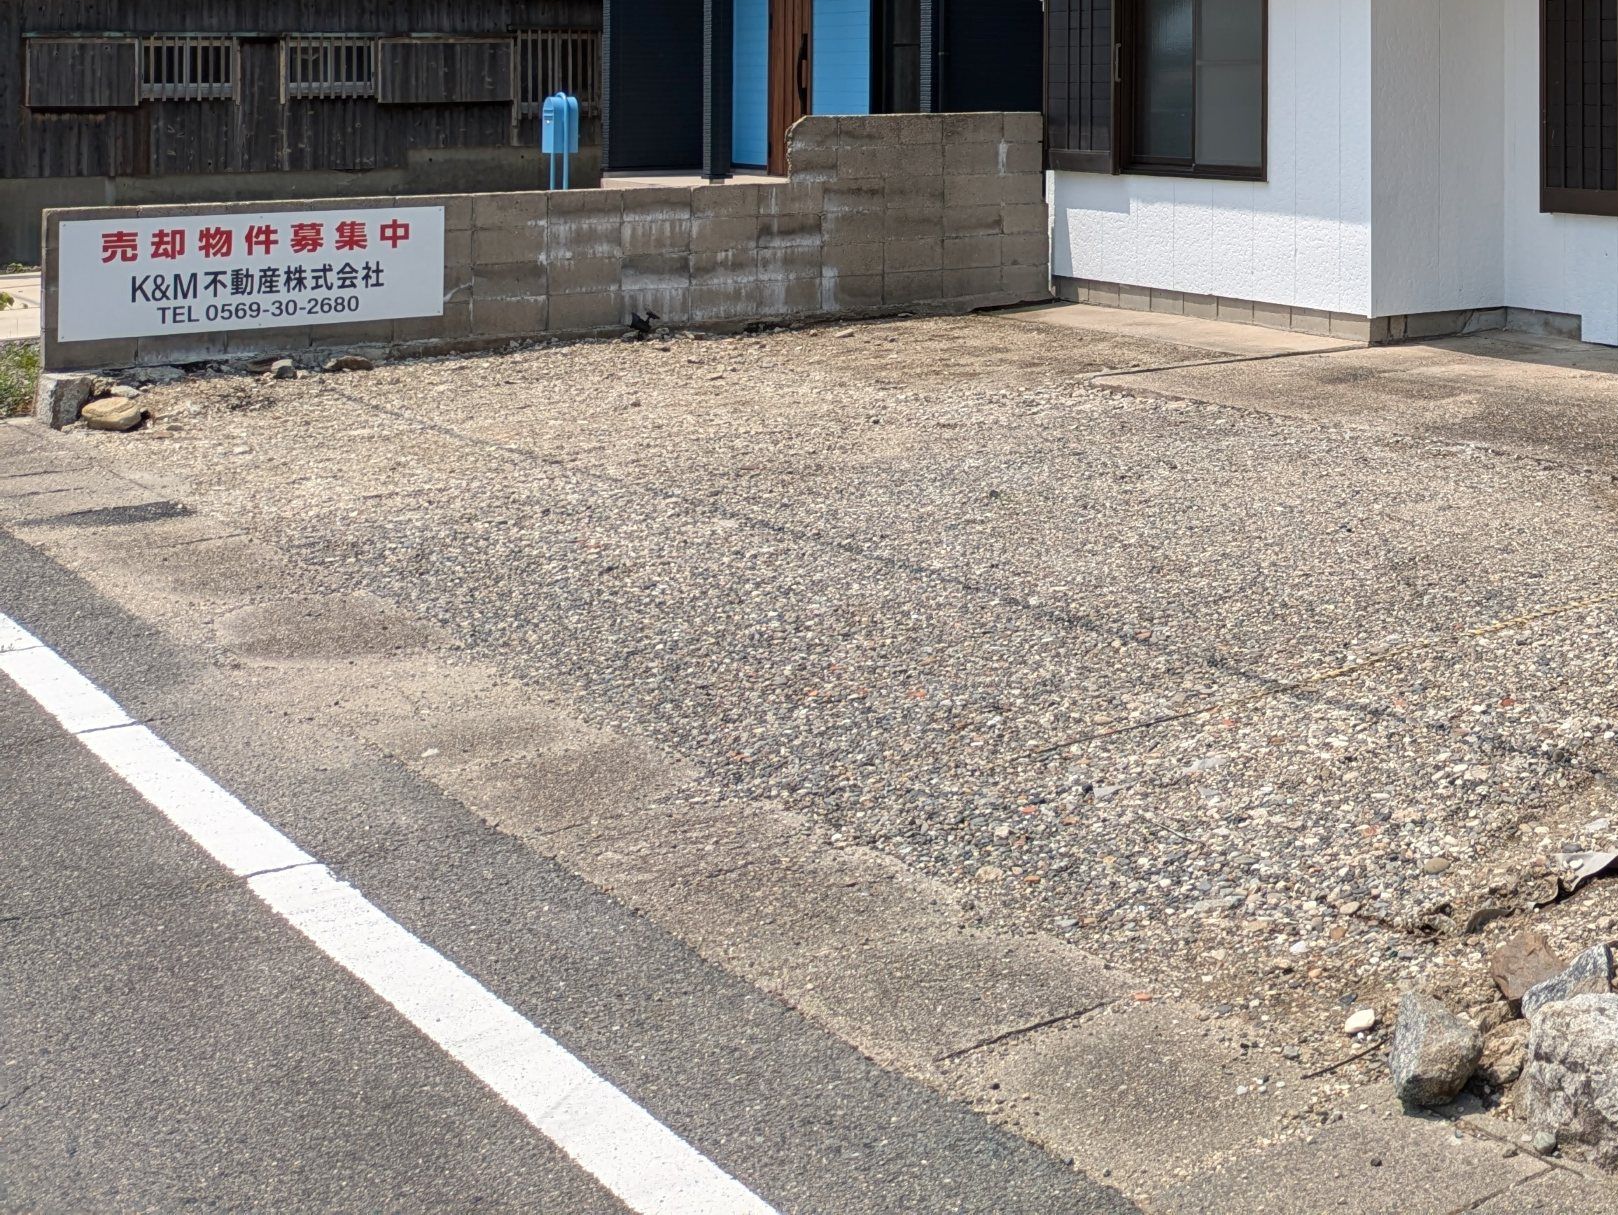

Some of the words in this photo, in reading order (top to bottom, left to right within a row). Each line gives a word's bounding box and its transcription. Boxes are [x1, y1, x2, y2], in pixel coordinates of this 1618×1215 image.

[101, 218, 411, 263] 売却物件募集中
[131, 260, 385, 303] K&M不動産株式会社
[156, 305, 200, 325] TEL
[205, 295, 360, 322] 0569-30-2680
